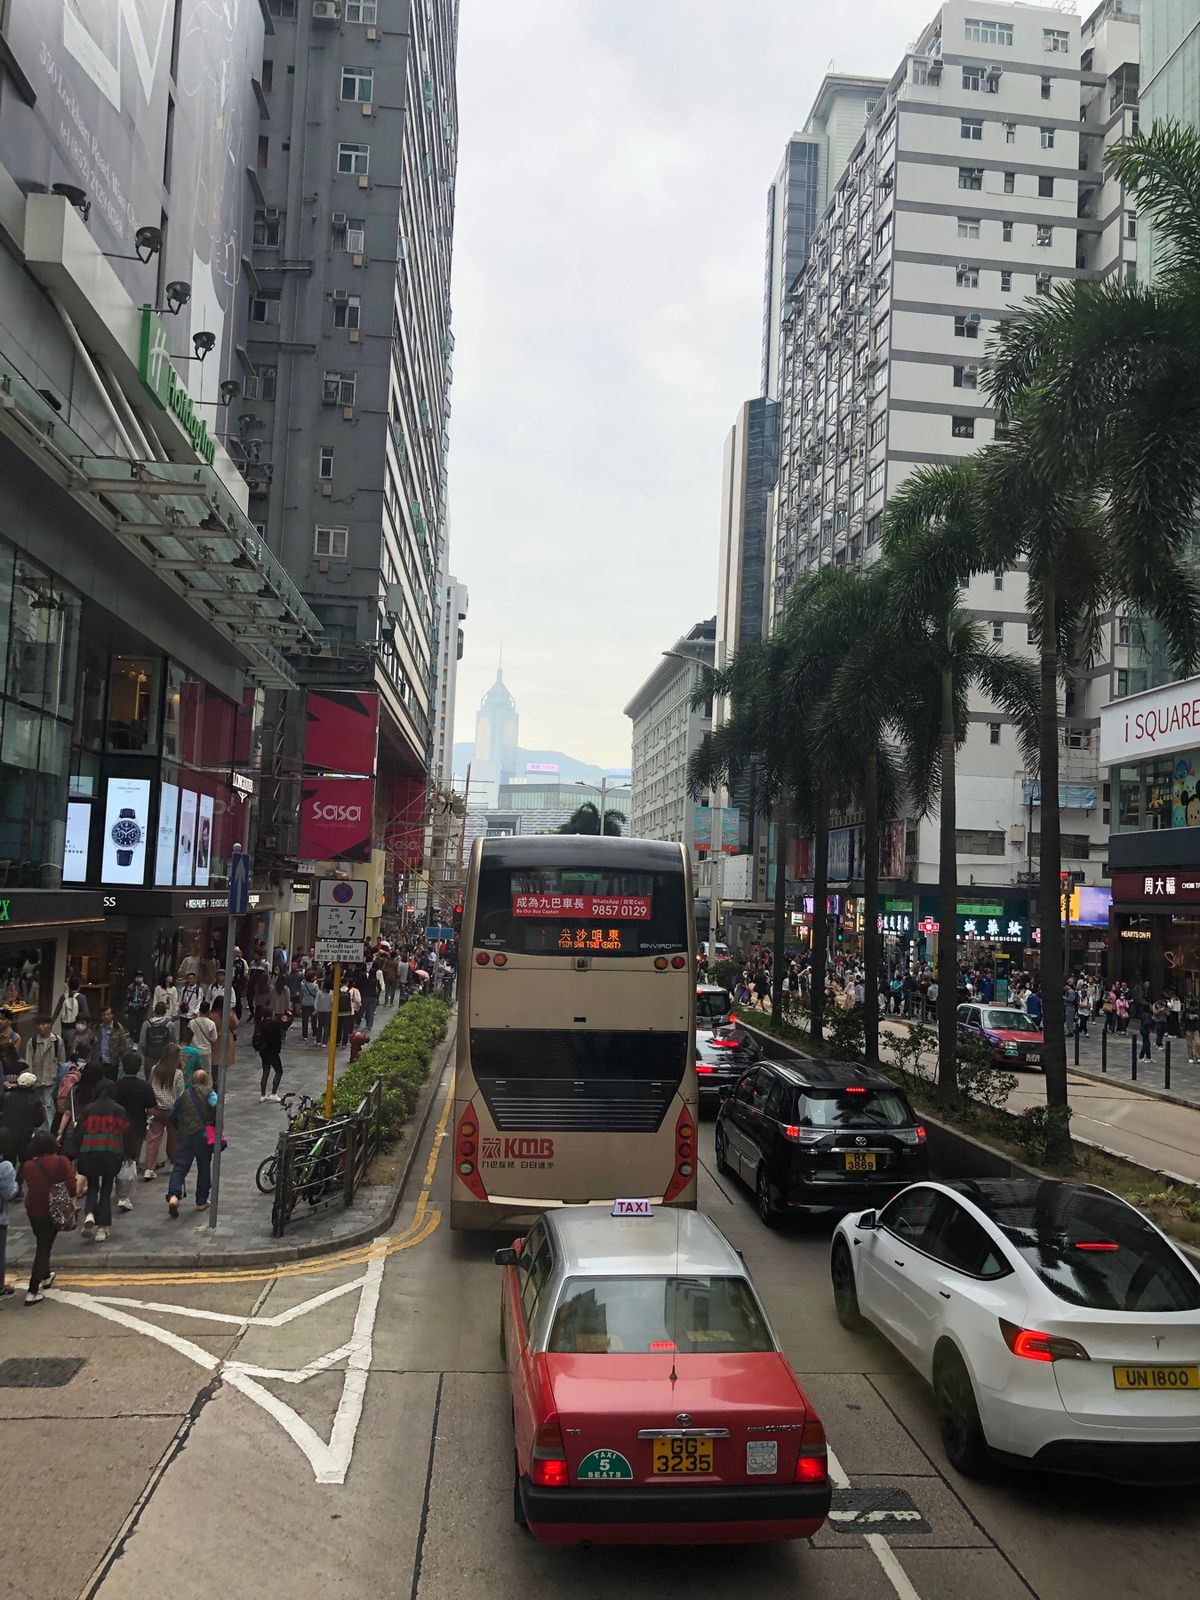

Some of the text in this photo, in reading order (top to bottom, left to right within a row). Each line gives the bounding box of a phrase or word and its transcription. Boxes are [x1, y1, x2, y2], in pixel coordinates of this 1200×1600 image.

[168, 364, 202, 453] Holiday
[1144, 876, 1176, 895] 周大福
[516, 897, 585, 909] 成為九巴車長
[349, 909, 357, 920] 7
[592, 905, 647, 917] 9857 0129
[348, 926, 356, 937] 7
[560, 928, 620, 942] 尖沙咀東
[854, 1152, 867, 1162] RX
[848, 1161, 873, 1170] 3869
[618, 1202, 648, 1213] TAXI
[1125, 1370, 1188, 1386] UN 1800
[671, 1438, 698, 1455] GG
[594, 1451, 617, 1460] TAXI
[599, 1459, 610, 1471] 5
[656, 1454, 711, 1473] 3235
